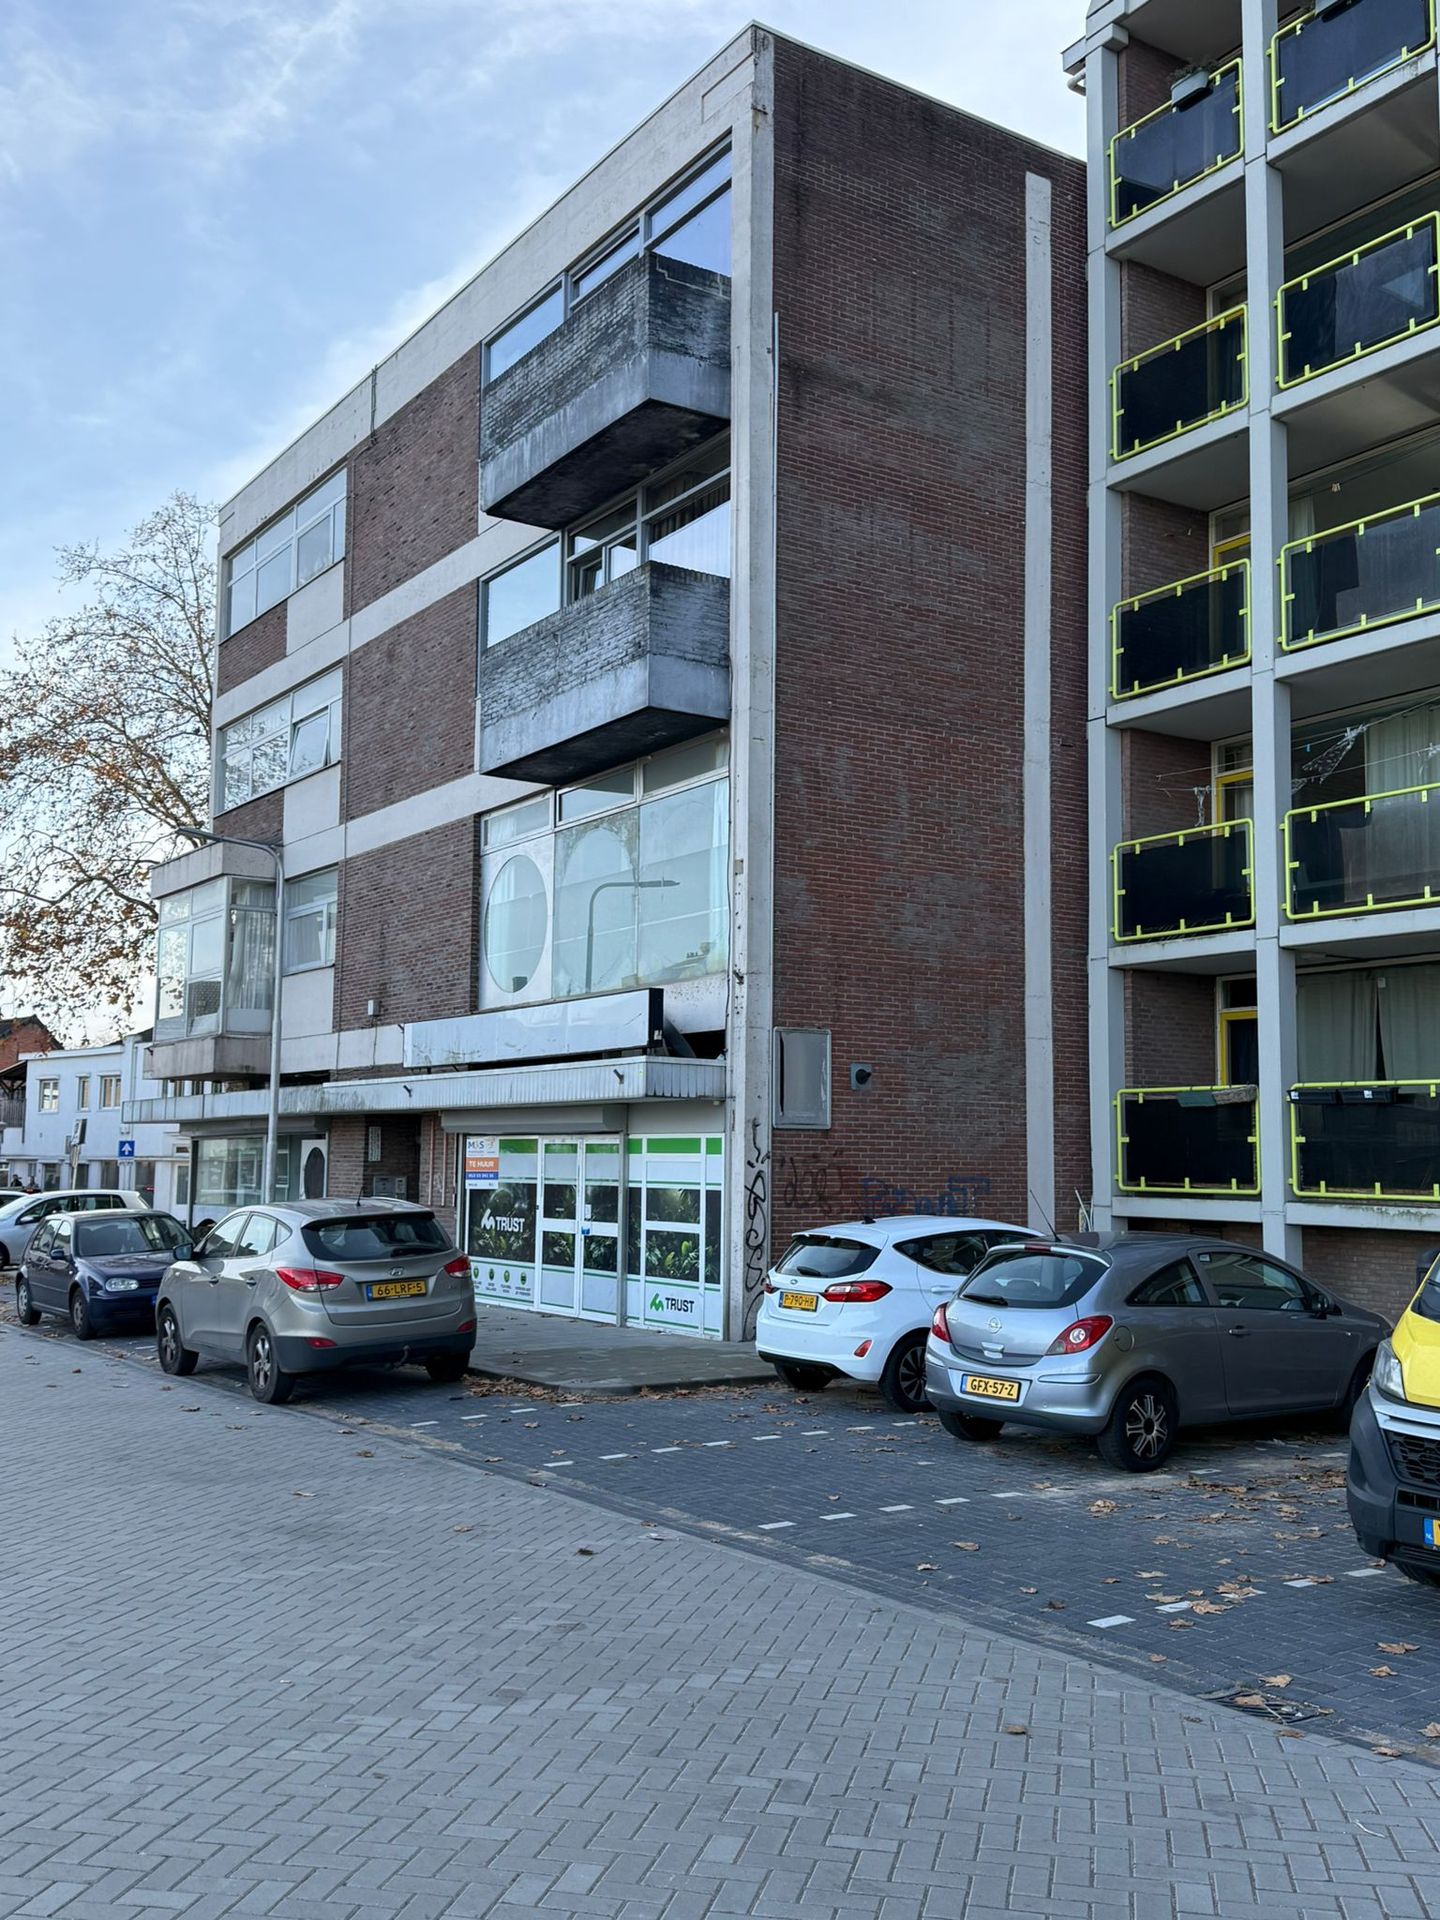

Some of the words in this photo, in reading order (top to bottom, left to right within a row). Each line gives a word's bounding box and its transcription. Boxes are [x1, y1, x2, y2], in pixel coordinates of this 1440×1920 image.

[495, 1216, 526, 1233] TRUST
[377, 1282, 423, 1296] 66-LRF-5
[665, 1296, 695, 1313] TRUST
[970, 1378, 1015, 1397] GFX-57-Z
